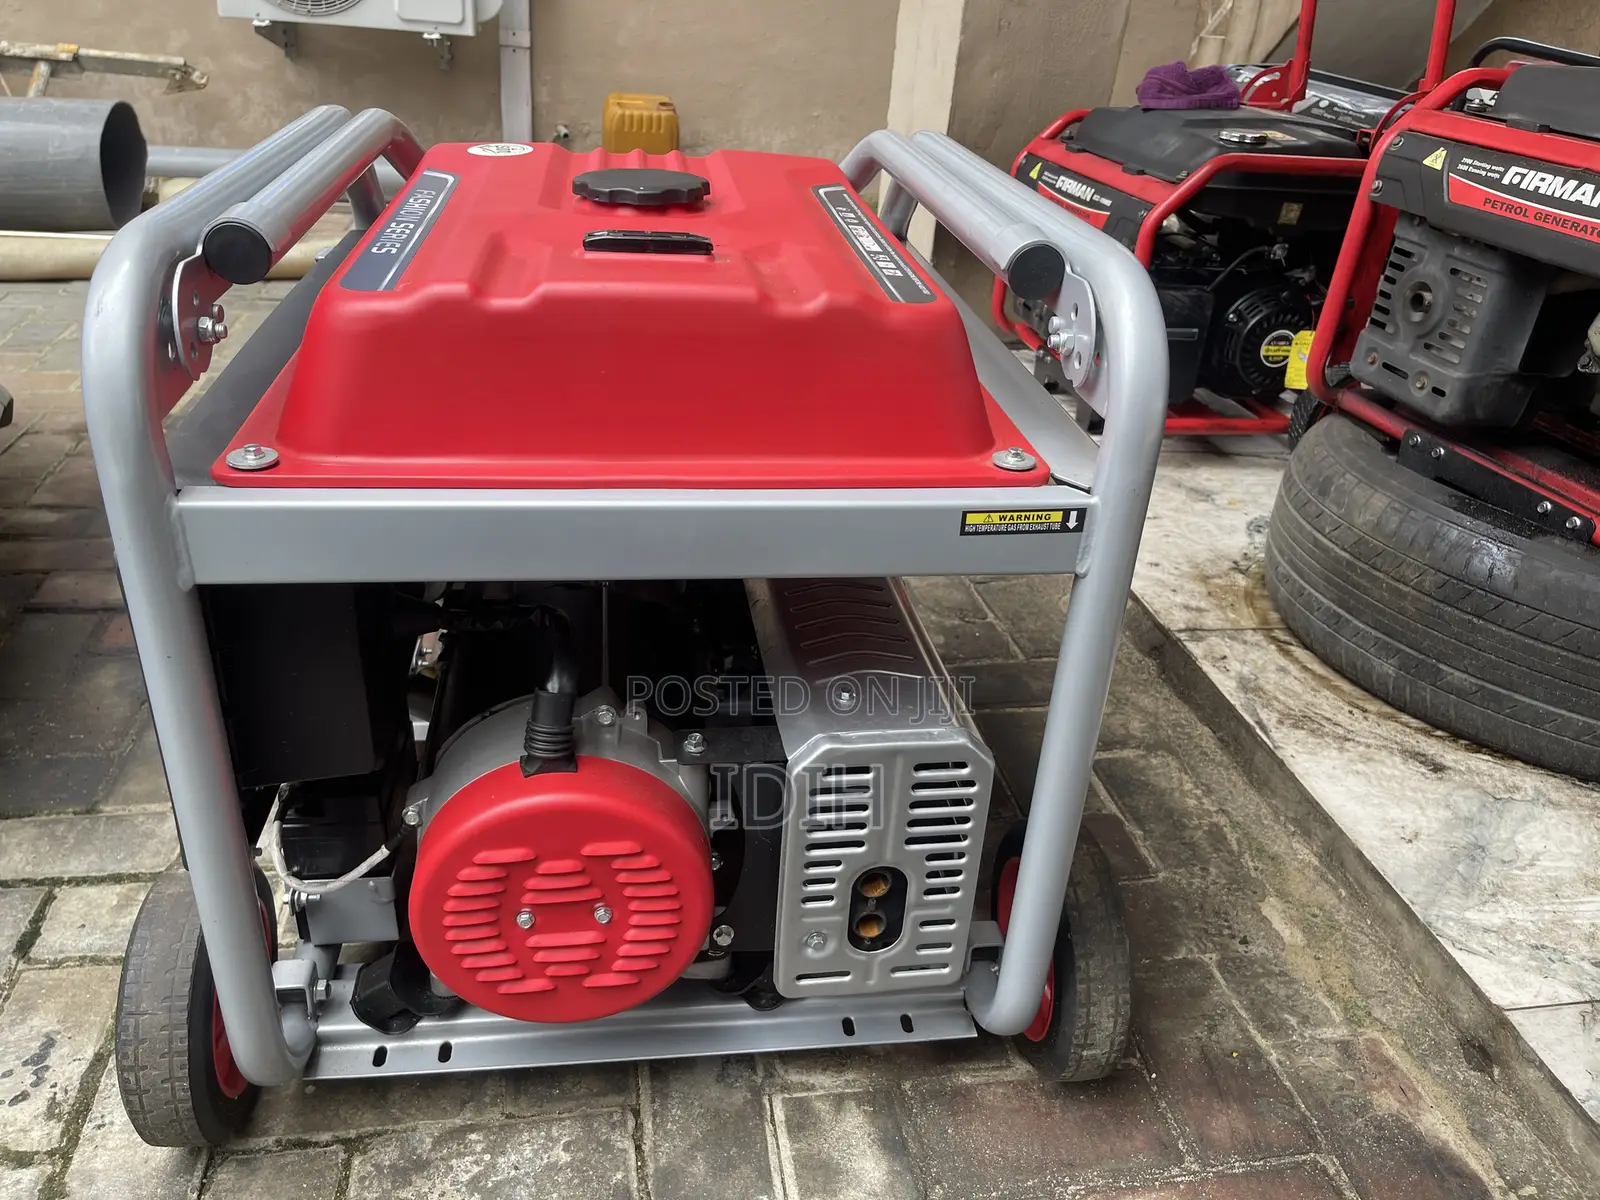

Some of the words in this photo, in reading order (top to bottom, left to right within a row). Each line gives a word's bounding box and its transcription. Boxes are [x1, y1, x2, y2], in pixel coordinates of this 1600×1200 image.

[1468, 166, 1487, 177] Running
[1472, 160, 1492, 170] Starting
[1055, 175, 1095, 202] FIRMAN
[395, 189, 436, 222] FASHION
[1482, 197, 1530, 219] PETROL
[1533, 211, 1600, 239] GENERAT
[370, 222, 415, 254] SERIES
[964, 524, 976, 532] HIGH
[976, 524, 1007, 532] TEMPERATURE
[1007, 524, 1017, 532] GAS
[1017, 523, 1029, 531] FROM
[1029, 522, 1050, 531] EXHAUST
[1049, 522, 1061, 530] TUBE
[998, 513, 1052, 522] WARNING
